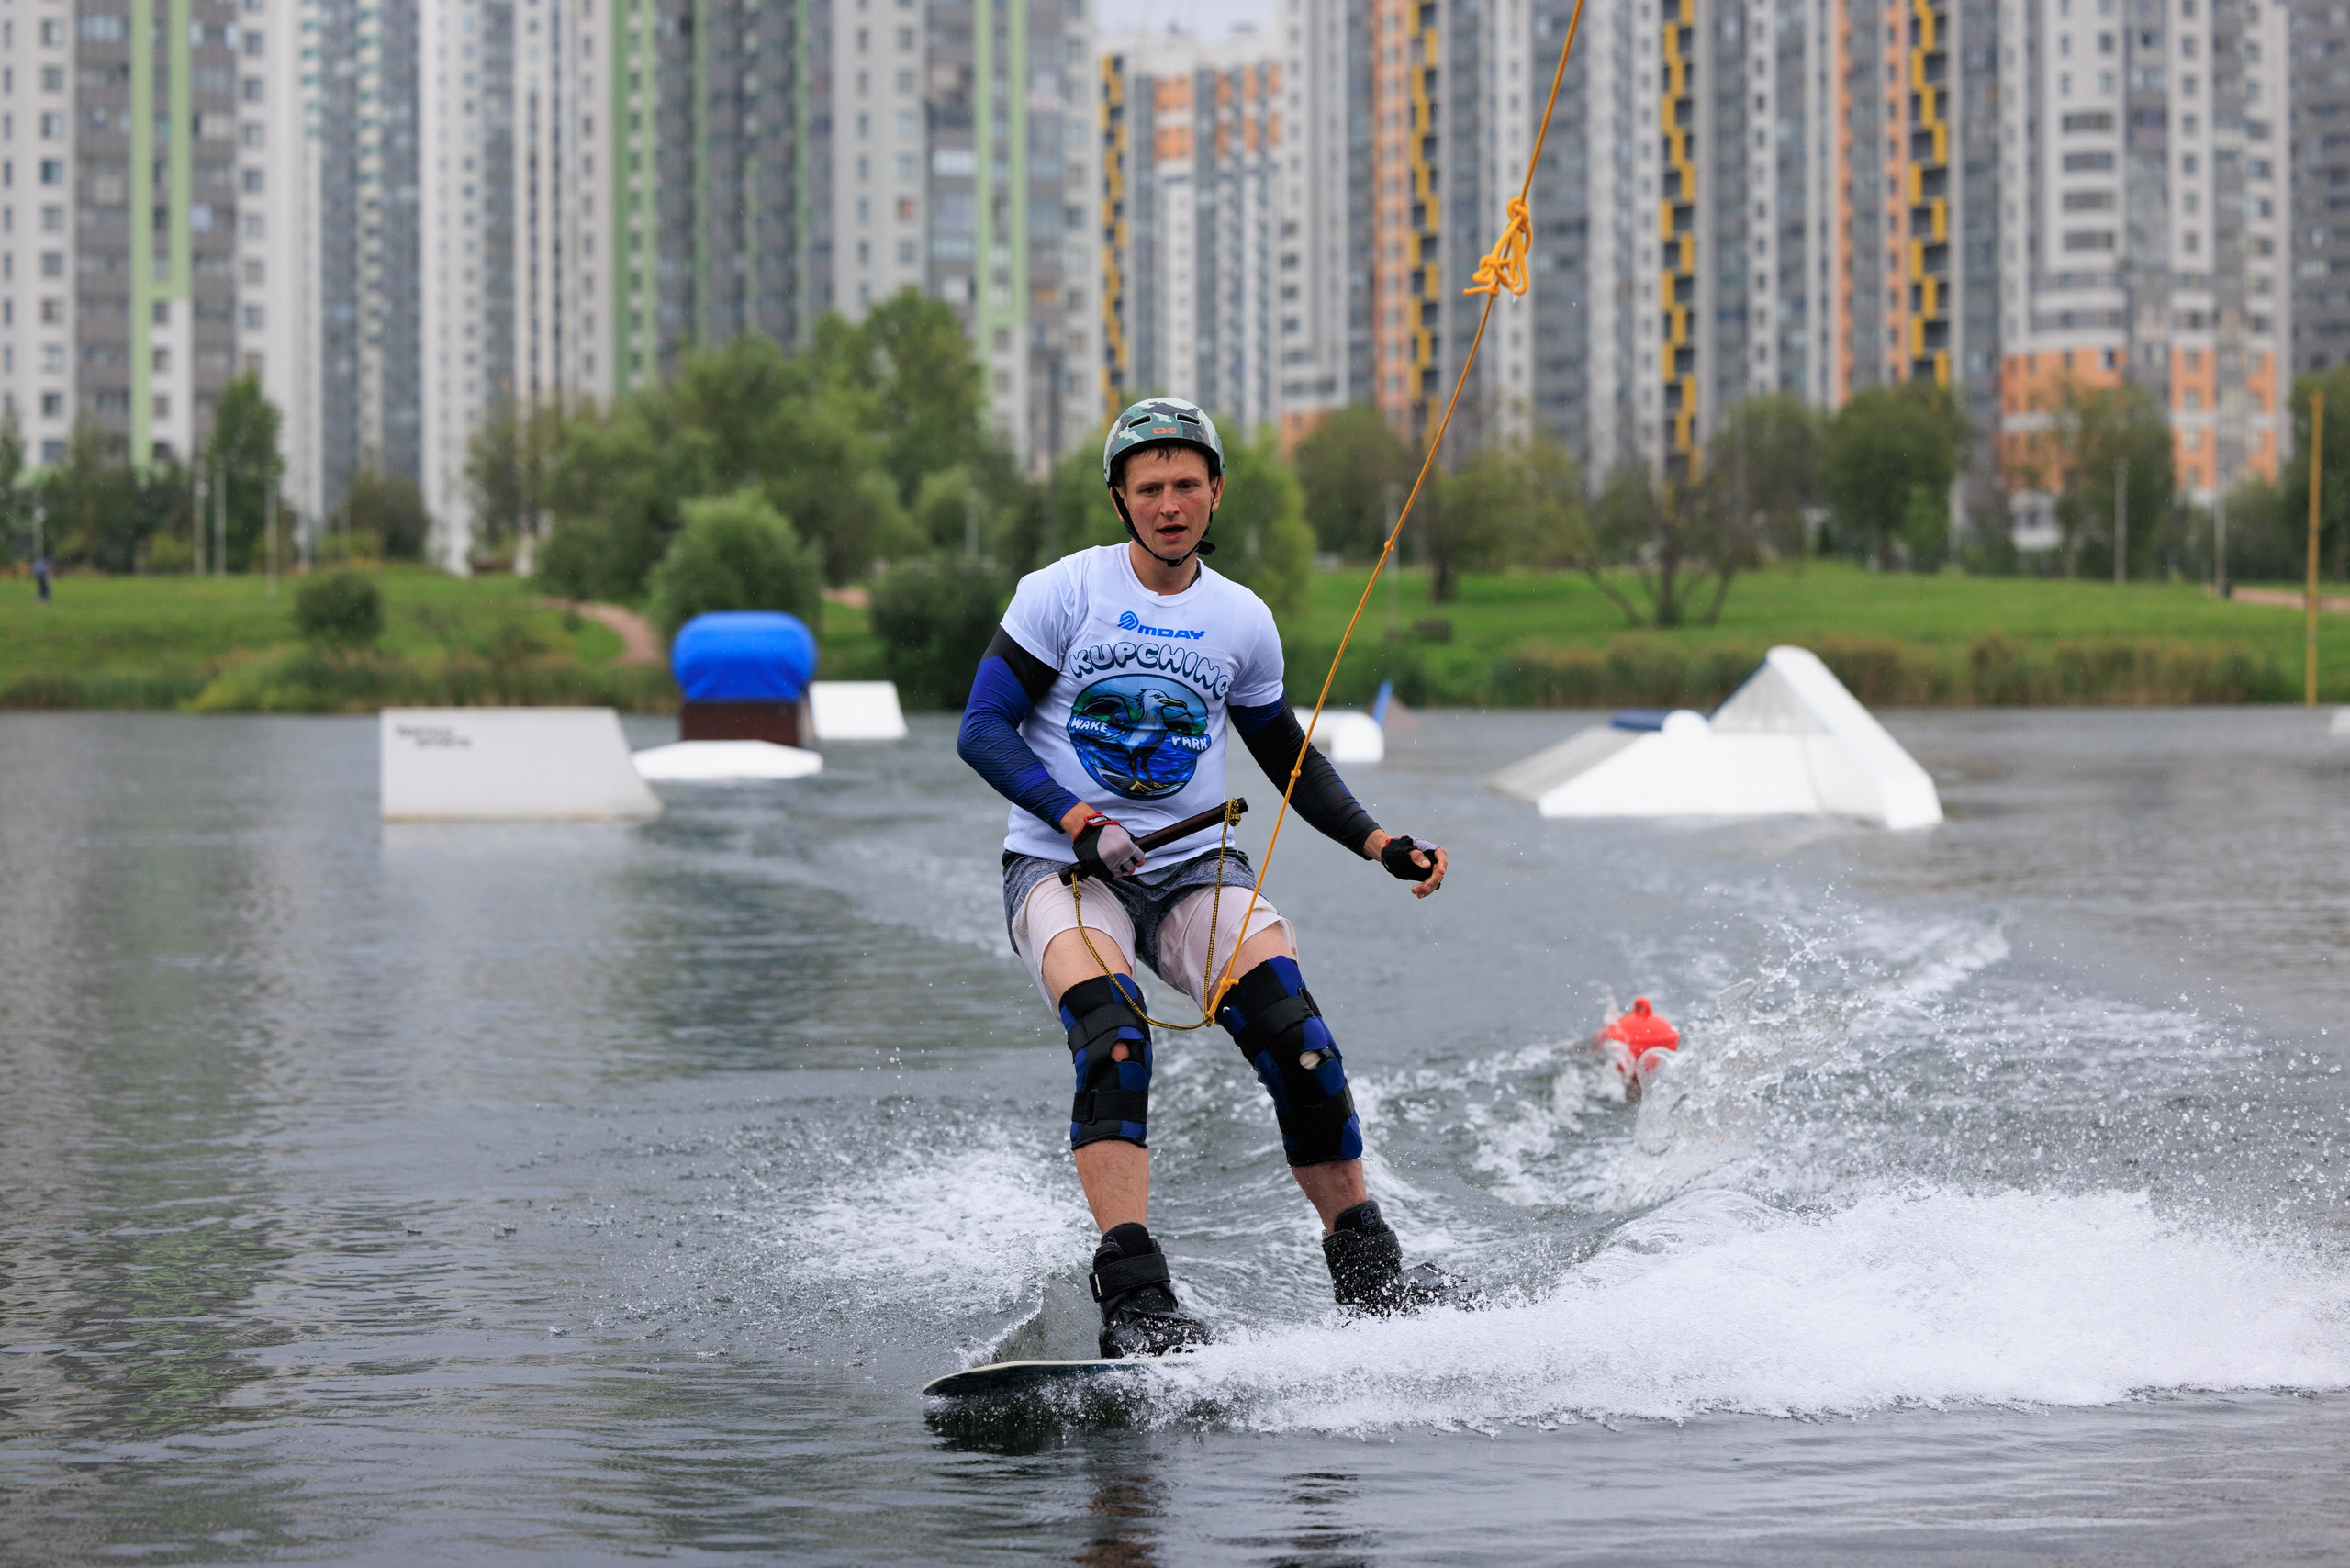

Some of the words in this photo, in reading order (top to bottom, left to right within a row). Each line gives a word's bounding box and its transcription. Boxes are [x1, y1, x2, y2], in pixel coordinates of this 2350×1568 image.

[1069, 642, 1229, 700] KUPCHINO
[1070, 717, 1109, 734] WAKE
[1171, 735, 1208, 751] PARK
